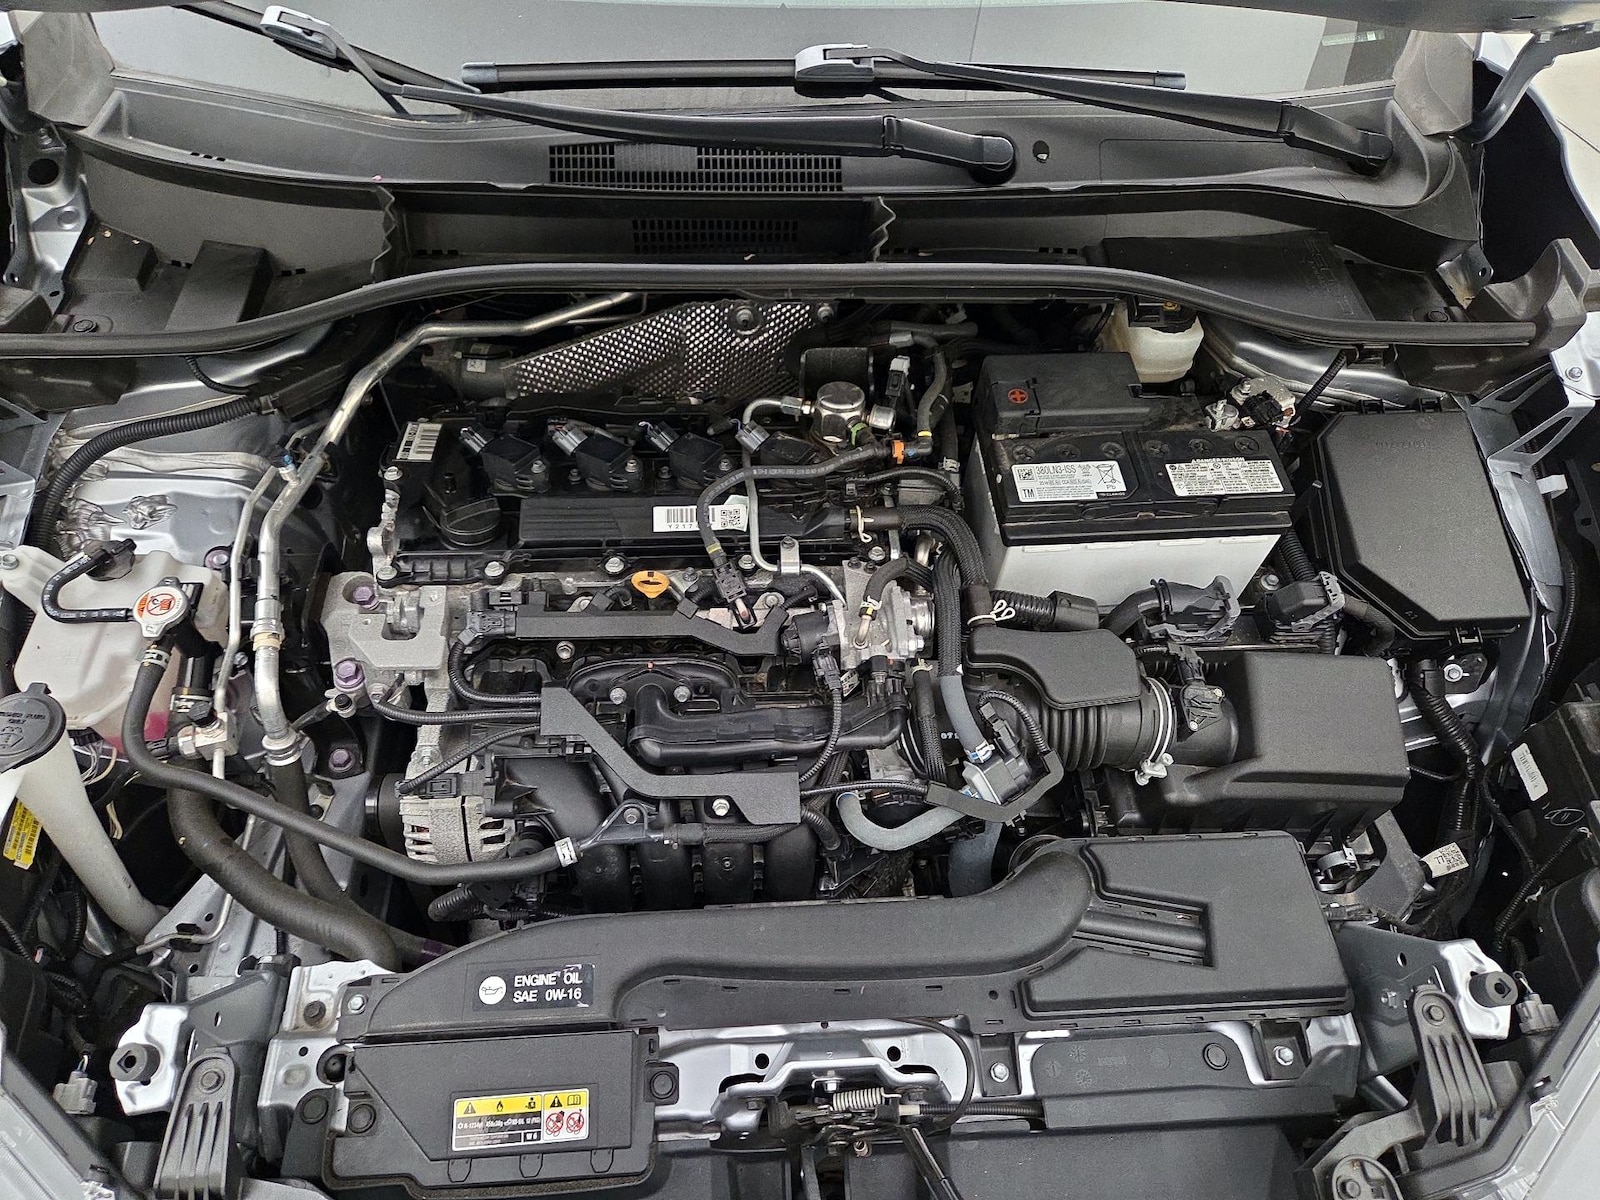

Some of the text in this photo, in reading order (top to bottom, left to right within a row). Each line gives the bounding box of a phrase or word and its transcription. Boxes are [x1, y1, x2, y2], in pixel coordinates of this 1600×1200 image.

[1022, 488, 1035, 498] TM
[514, 972, 583, 987] ENGINE OIL
[513, 987, 582, 1003] SAE 0W-16
